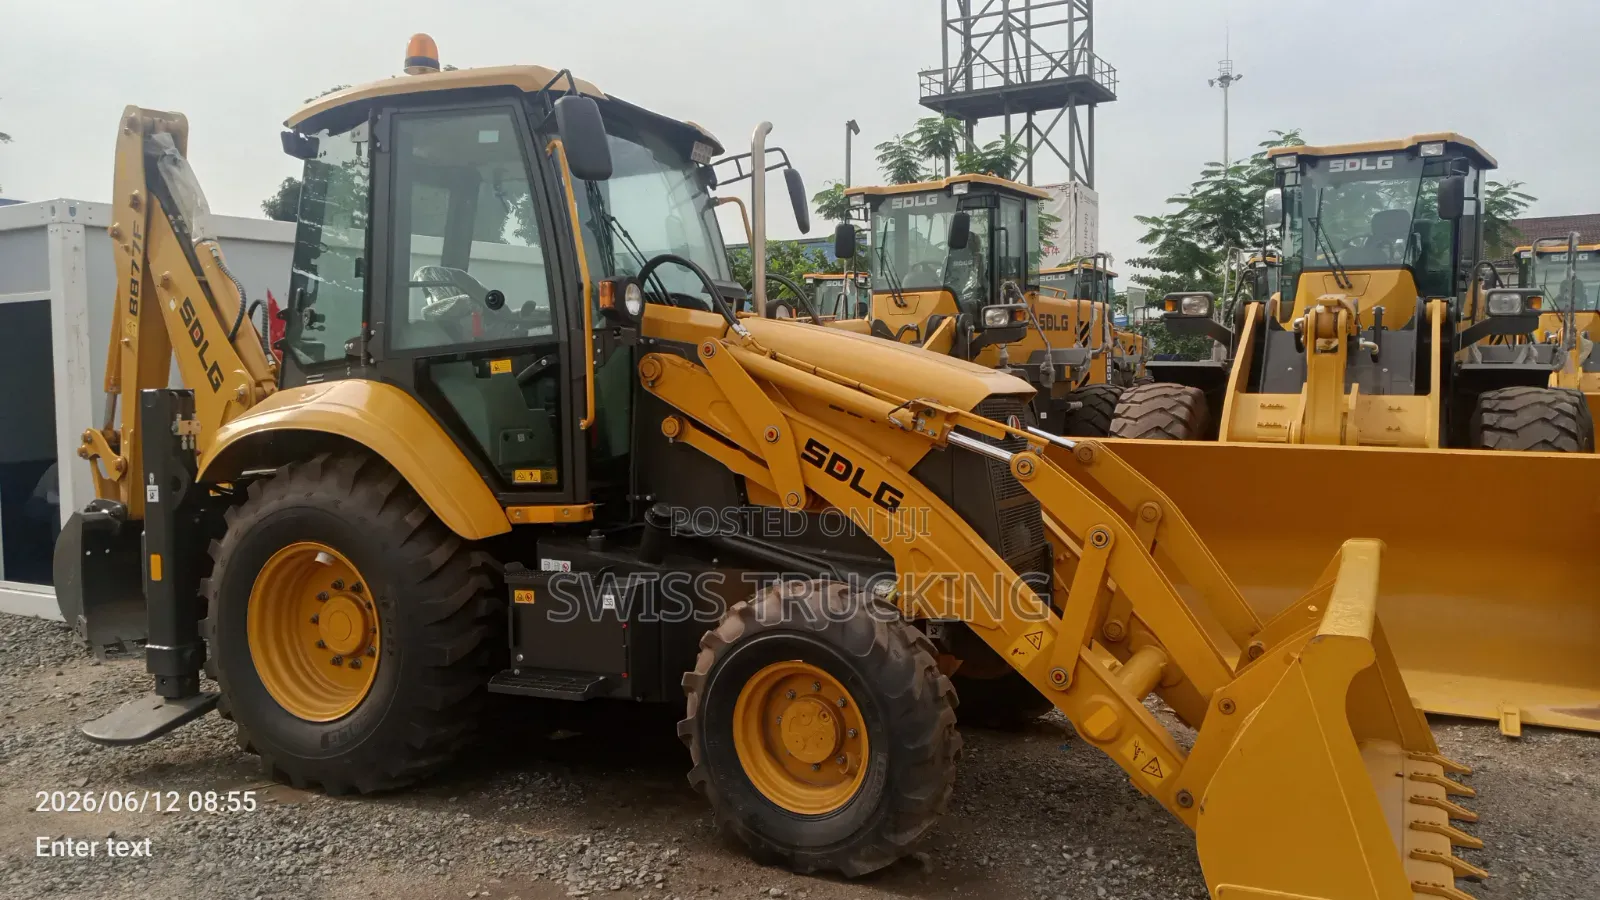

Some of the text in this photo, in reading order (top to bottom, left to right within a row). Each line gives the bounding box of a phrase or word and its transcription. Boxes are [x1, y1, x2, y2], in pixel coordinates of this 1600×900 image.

[1329, 156, 1394, 172] SDLG
[891, 194, 938, 209] SDLG
[1551, 253, 1588, 261] SDG
[1039, 273, 1066, 283] SDLG
[1039, 313, 1069, 331] SDLG
[179, 297, 224, 393] SDLG
[800, 437, 904, 514] SDLG
